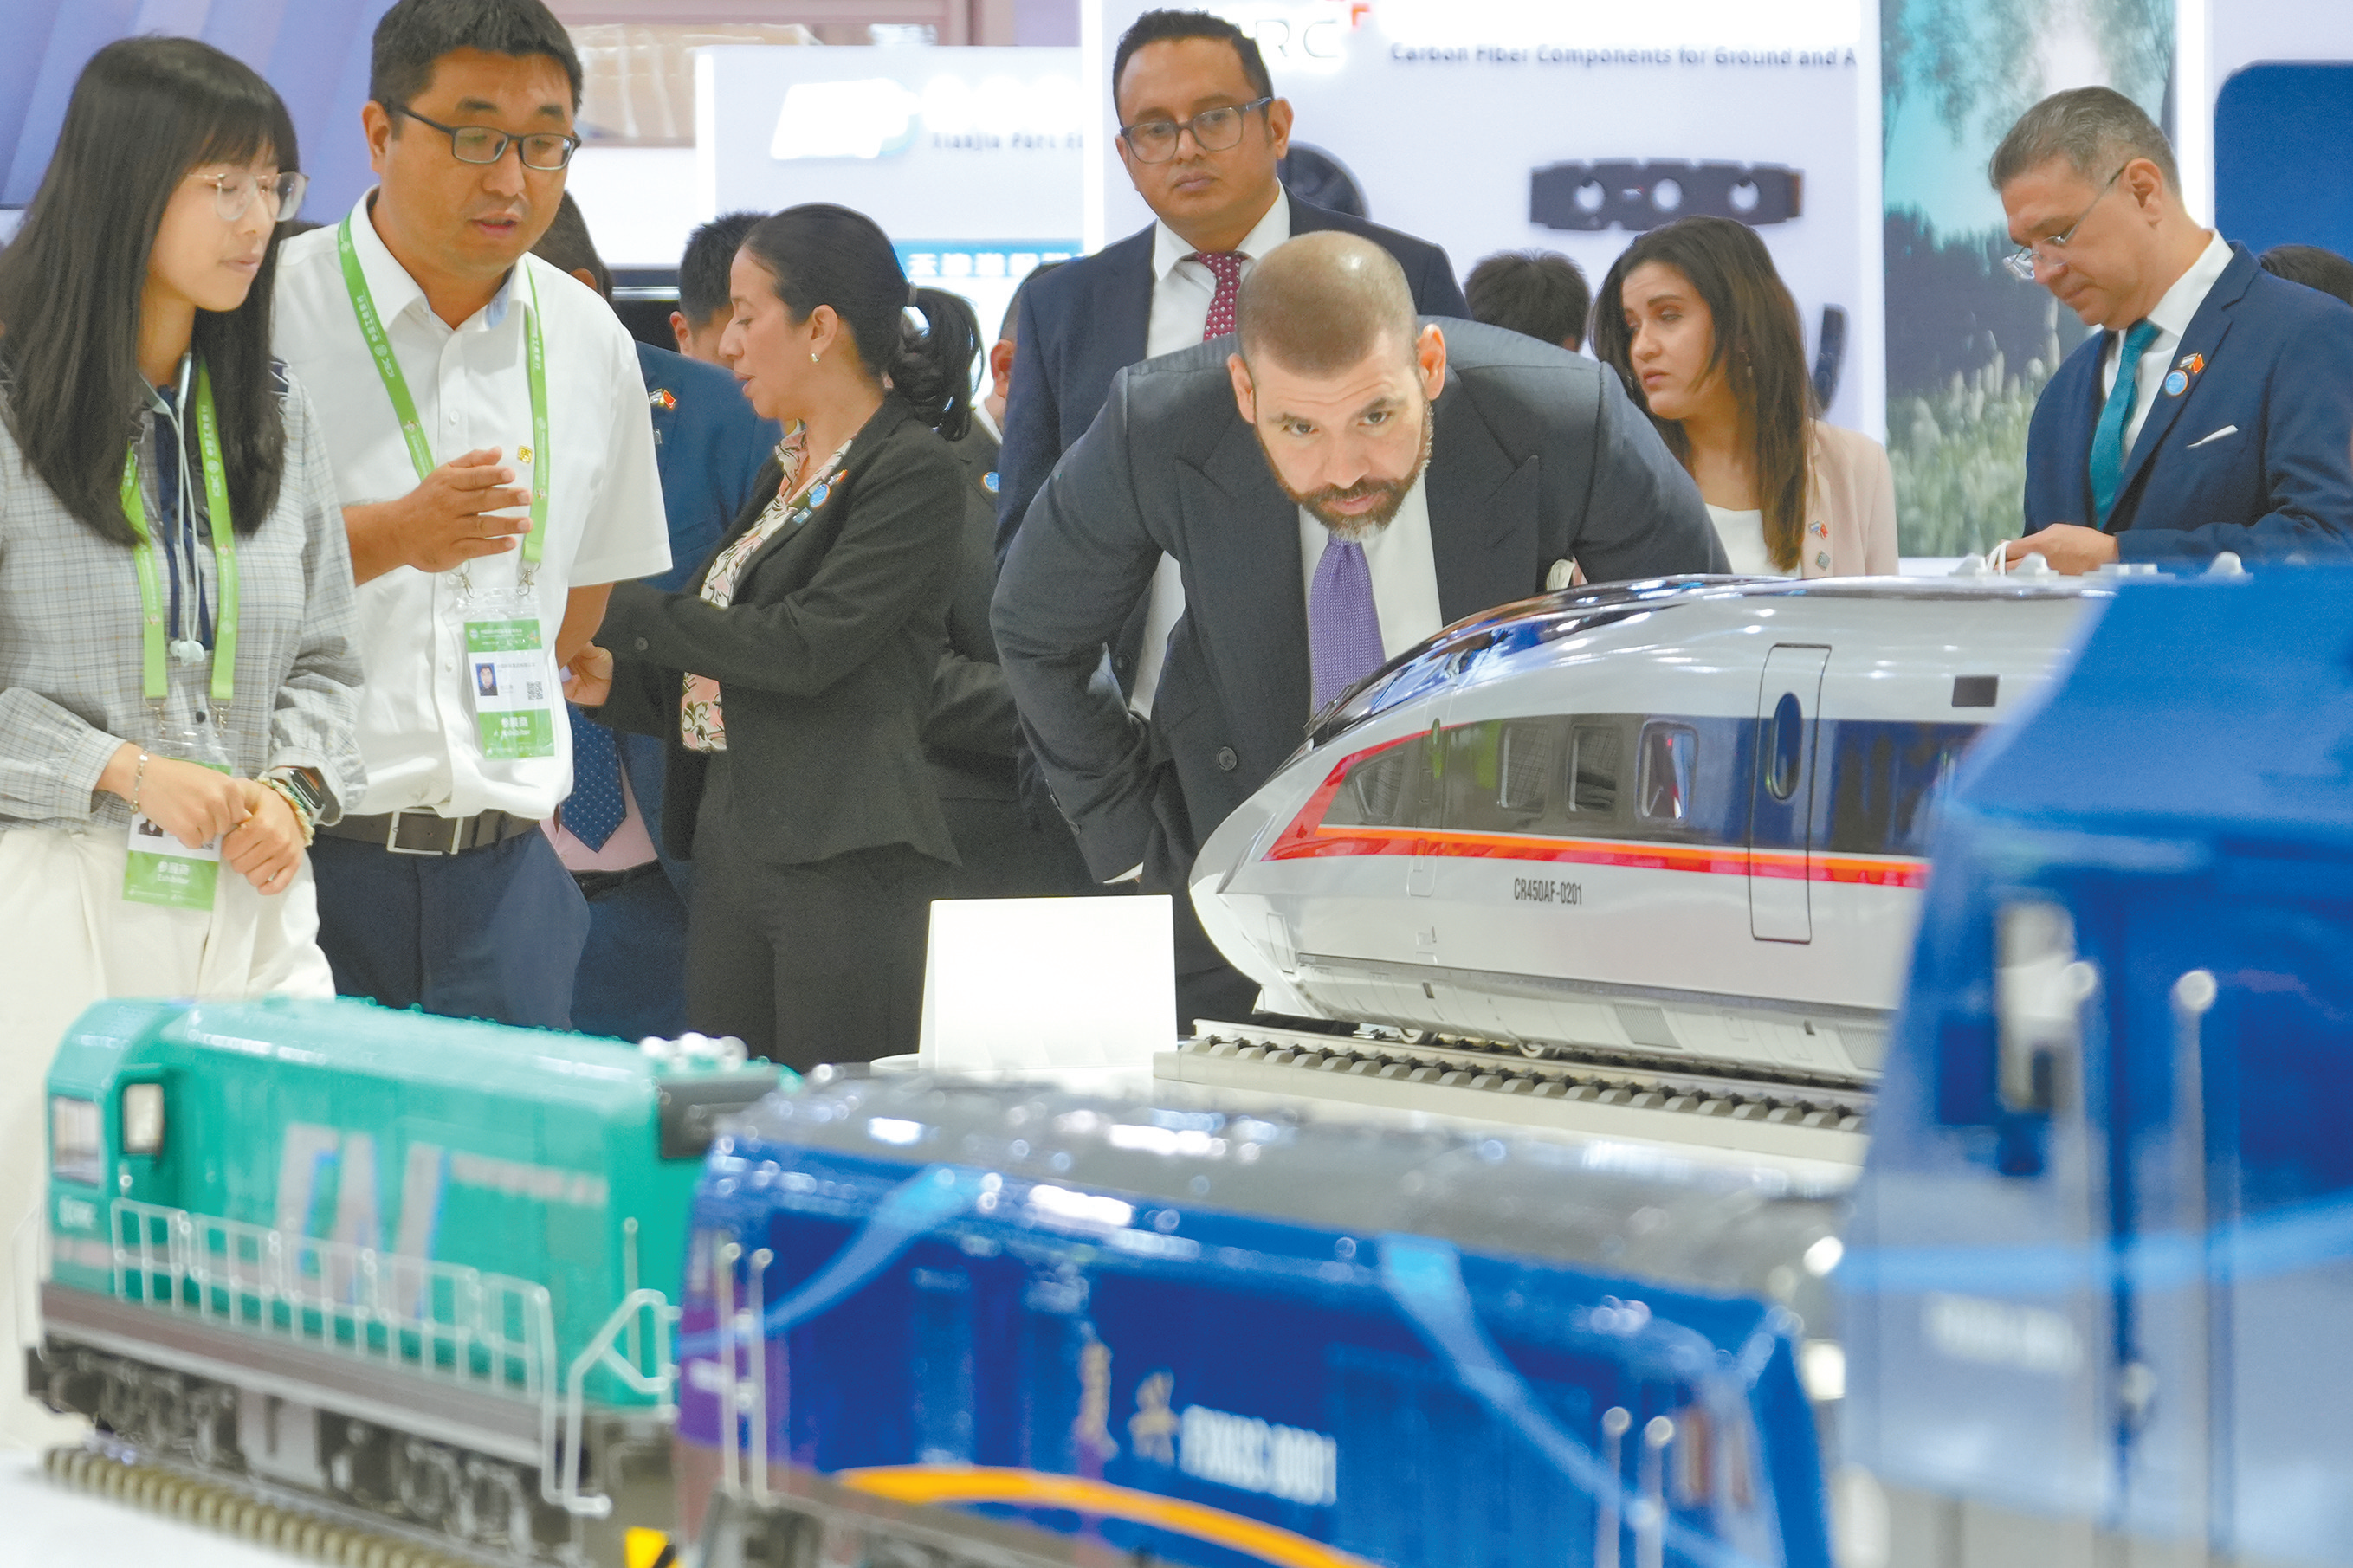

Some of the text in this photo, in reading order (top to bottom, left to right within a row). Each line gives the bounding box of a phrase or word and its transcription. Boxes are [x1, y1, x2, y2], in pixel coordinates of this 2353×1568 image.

[1391, 43, 1468, 61] Carbon
[1476, 44, 1528, 61] Fiber
[1537, 44, 1671, 68] Components
[1679, 45, 1705, 64] for
[1716, 46, 1791, 64] Ground
[1799, 47, 1837, 64] and
[1514, 877, 1582, 905] CR450AF-0201
